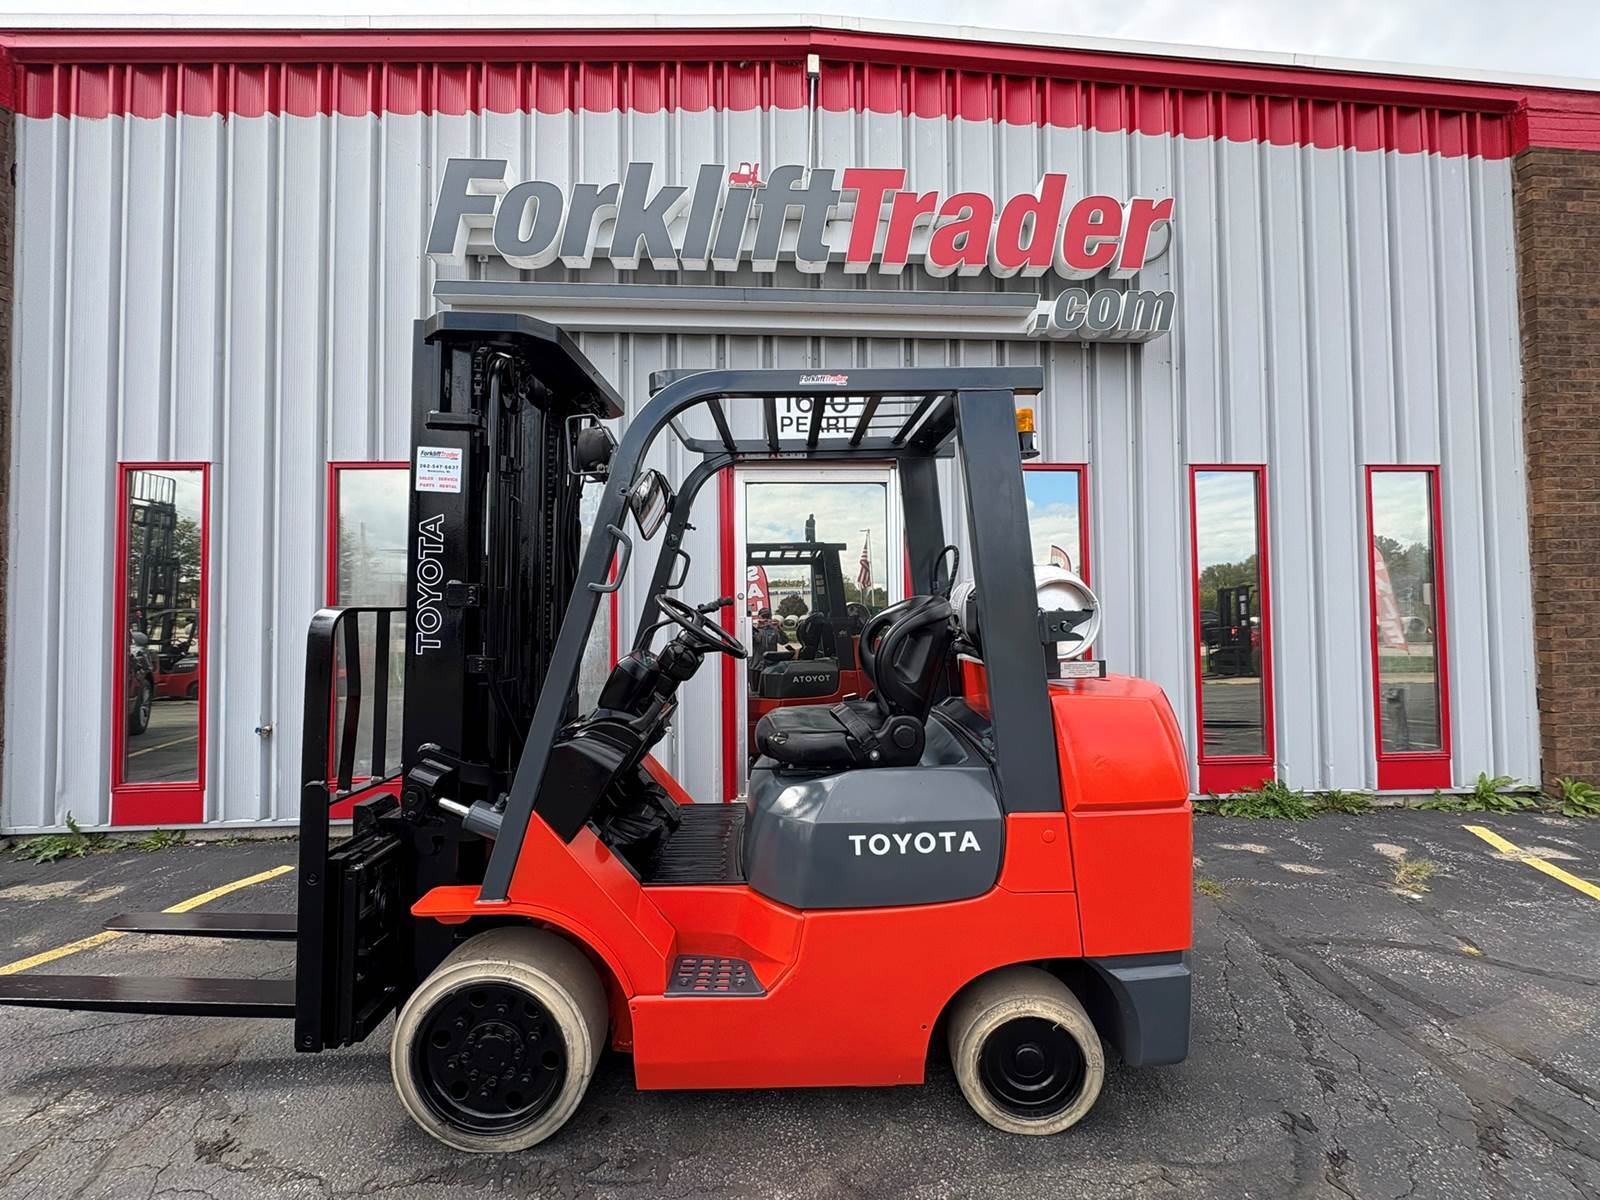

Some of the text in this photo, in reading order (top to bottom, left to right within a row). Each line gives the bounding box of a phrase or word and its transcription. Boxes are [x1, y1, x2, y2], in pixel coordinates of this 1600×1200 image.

[425, 158, 1175, 274] ForkliftTrader
[1035, 287, 1177, 332] .com
[786, 397, 850, 413] 160
[780, 416, 854, 433] PERL
[416, 513, 445, 655] TOYOTA
[848, 830, 981, 856] TOYOTA
